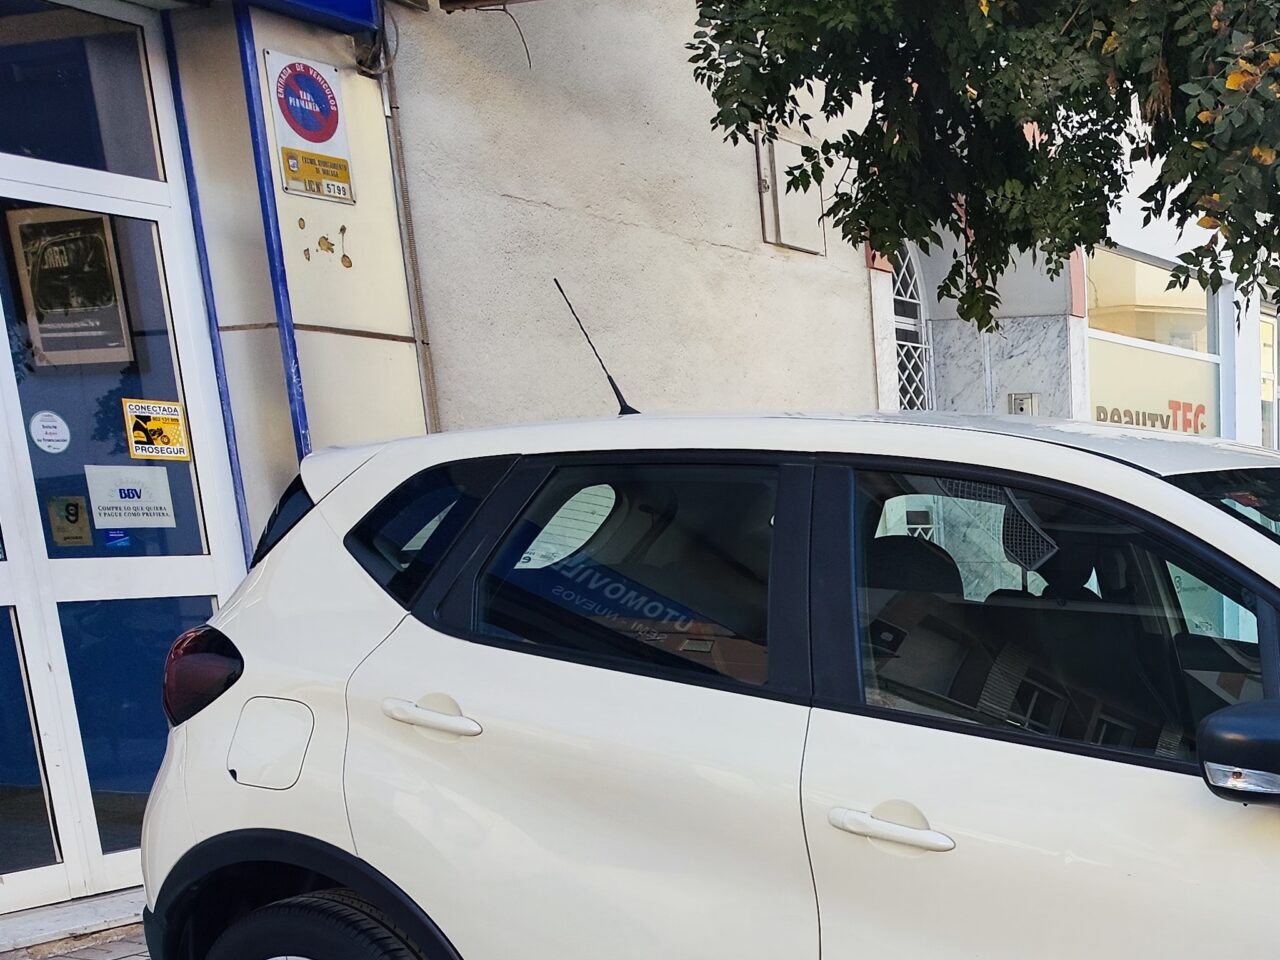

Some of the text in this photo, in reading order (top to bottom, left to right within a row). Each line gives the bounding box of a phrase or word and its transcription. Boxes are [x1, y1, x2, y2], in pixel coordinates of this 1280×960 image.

[277, 63, 337, 111] ENTRADA DE VEHICULOS
[128, 404, 179, 414] CONECTADA
[134, 446, 185, 455] PROSEGUR
[118, 488, 142, 499] BBV
